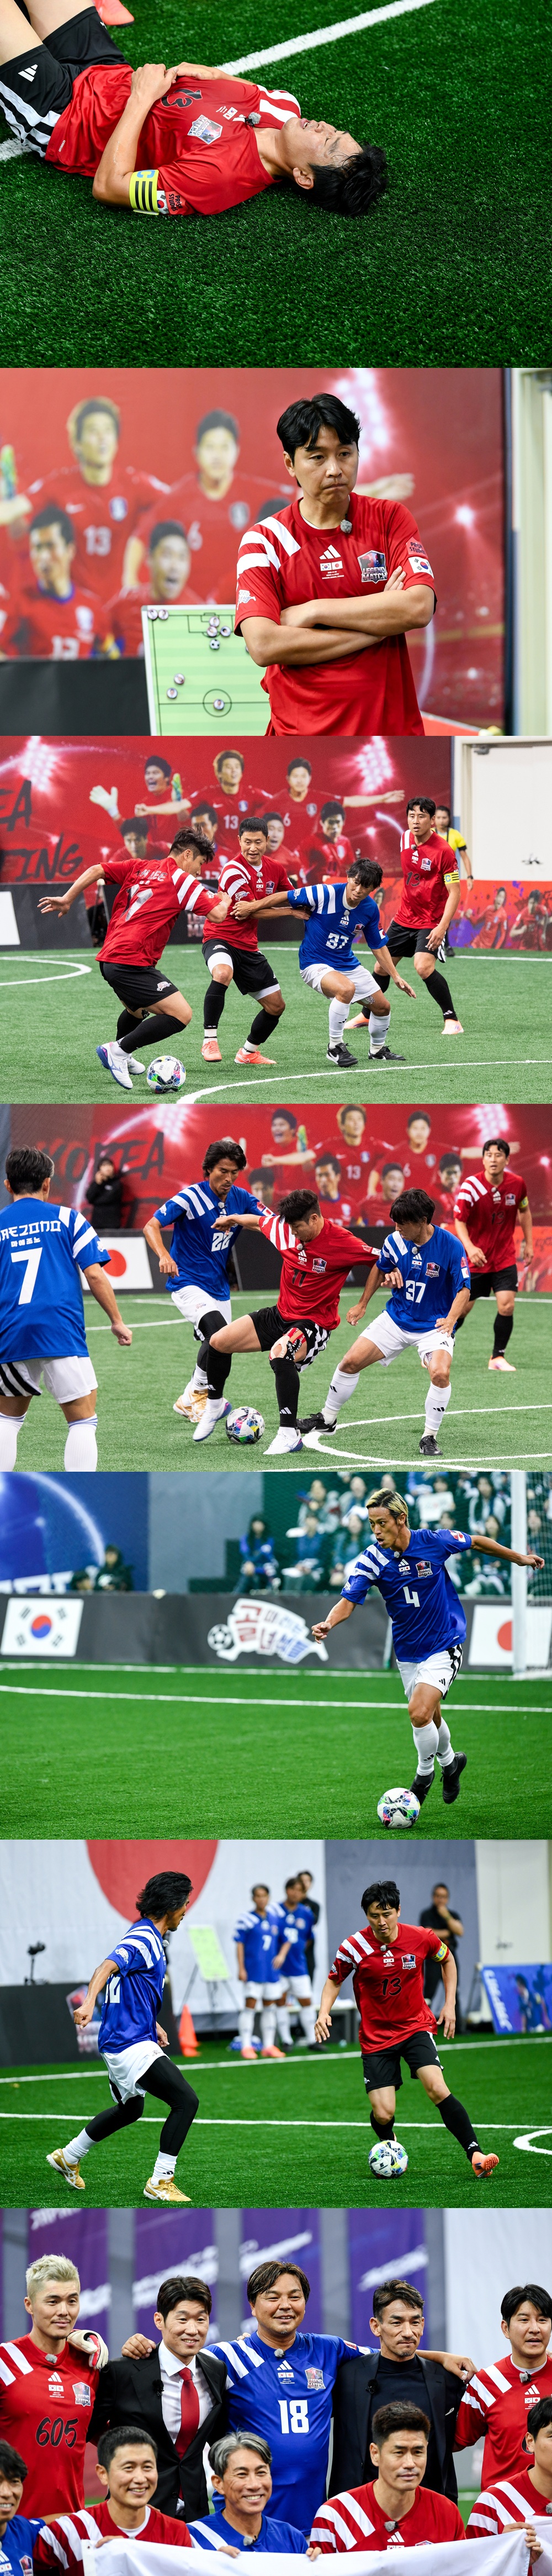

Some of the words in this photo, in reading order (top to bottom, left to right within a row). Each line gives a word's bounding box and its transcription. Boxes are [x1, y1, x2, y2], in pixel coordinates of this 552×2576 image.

[161, 88, 203, 108] 13
[137, 170, 155, 178] C
[84, 525, 112, 556] 13
[188, 521, 202, 551] 6
[362, 572, 388, 581] MATCH
[224, 815, 238, 829] 13
[283, 812, 291, 827] 6
[406, 871, 420, 887] 13
[326, 933, 349, 949] 37
[347, 1165, 361, 1180] 13
[403, 1163, 411, 1177] 6
[0, 1220, 61, 1242] AEZONO
[211, 1232, 234, 1252] 22
[10, 1247, 43, 1305] 7
[292, 1269, 307, 1288] 11
[405, 1280, 426, 1303] 37
[402, 1586, 421, 1608] 4
[262, 1935, 272, 1951] 7
[438, 1948, 445, 1957] C
[381, 1977, 402, 1996] 13
[278, 2400, 310, 2434] 18
[35, 2416, 78, 2449] 605
